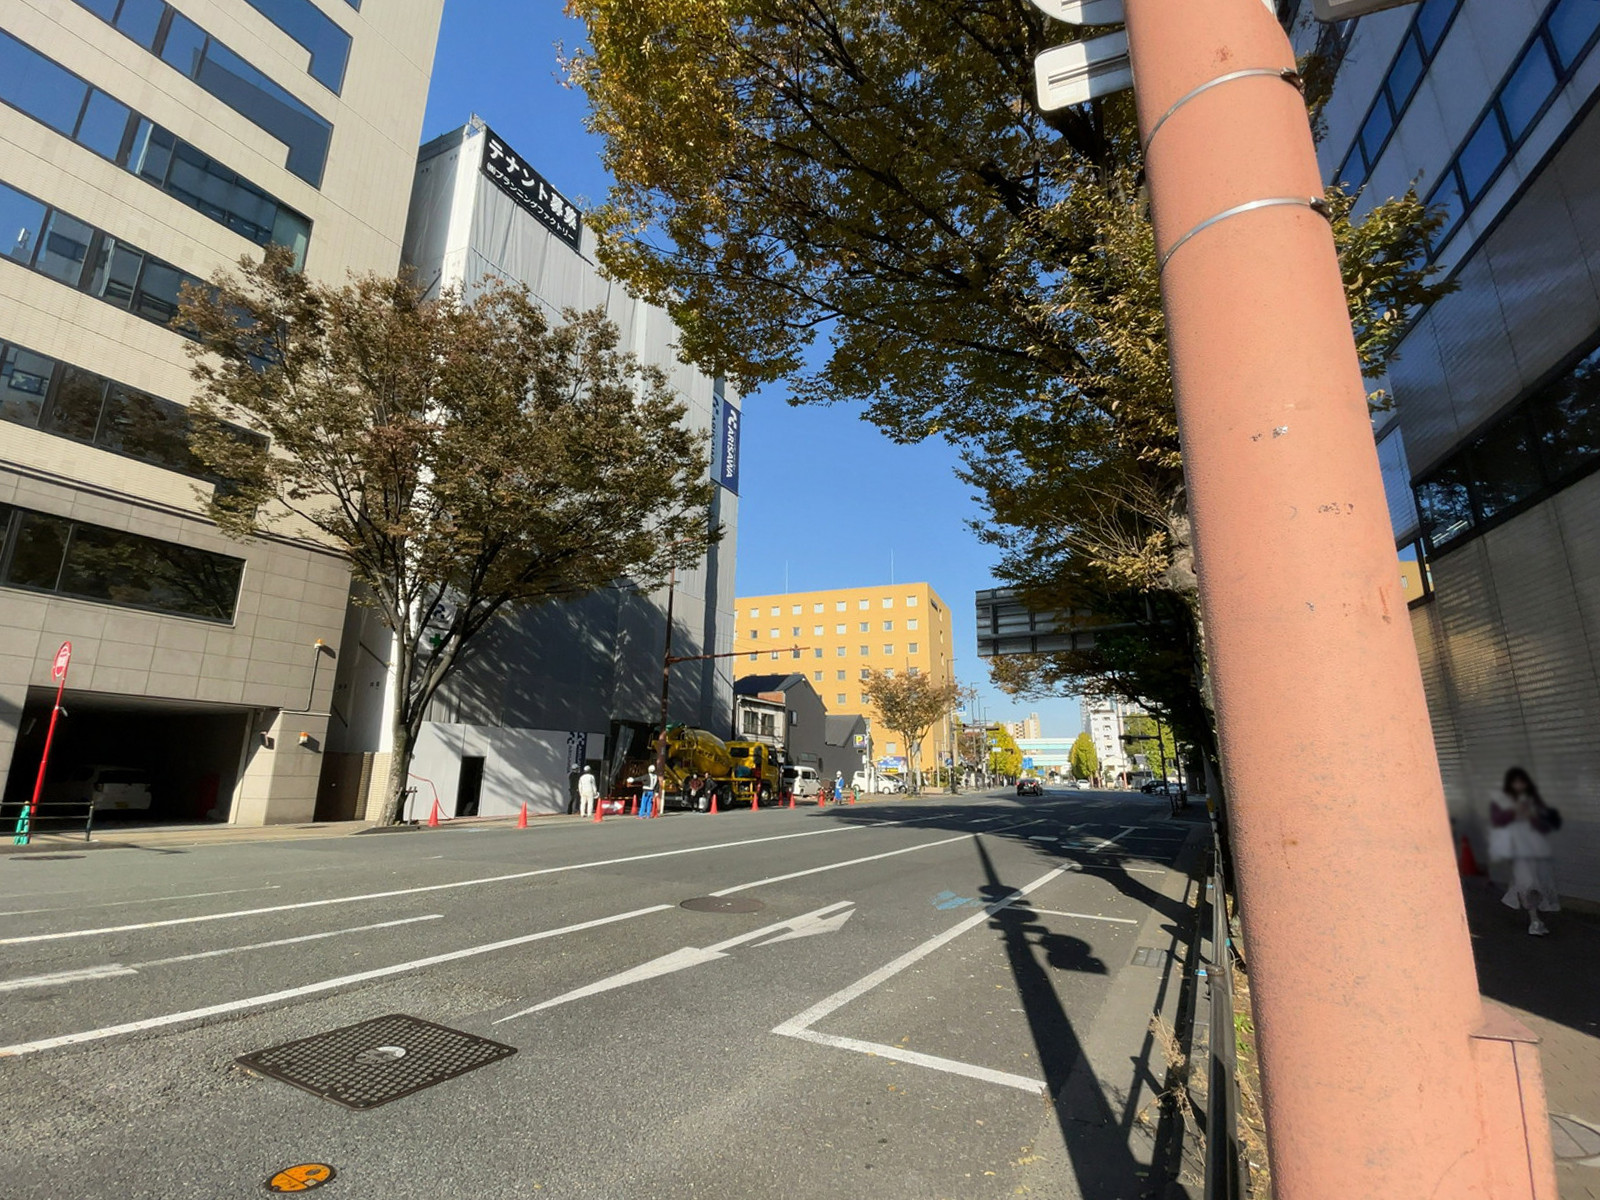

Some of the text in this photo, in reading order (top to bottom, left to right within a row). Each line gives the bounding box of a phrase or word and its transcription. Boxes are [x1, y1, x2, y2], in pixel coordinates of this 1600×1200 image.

[488, 139, 577, 230] テナント募集
